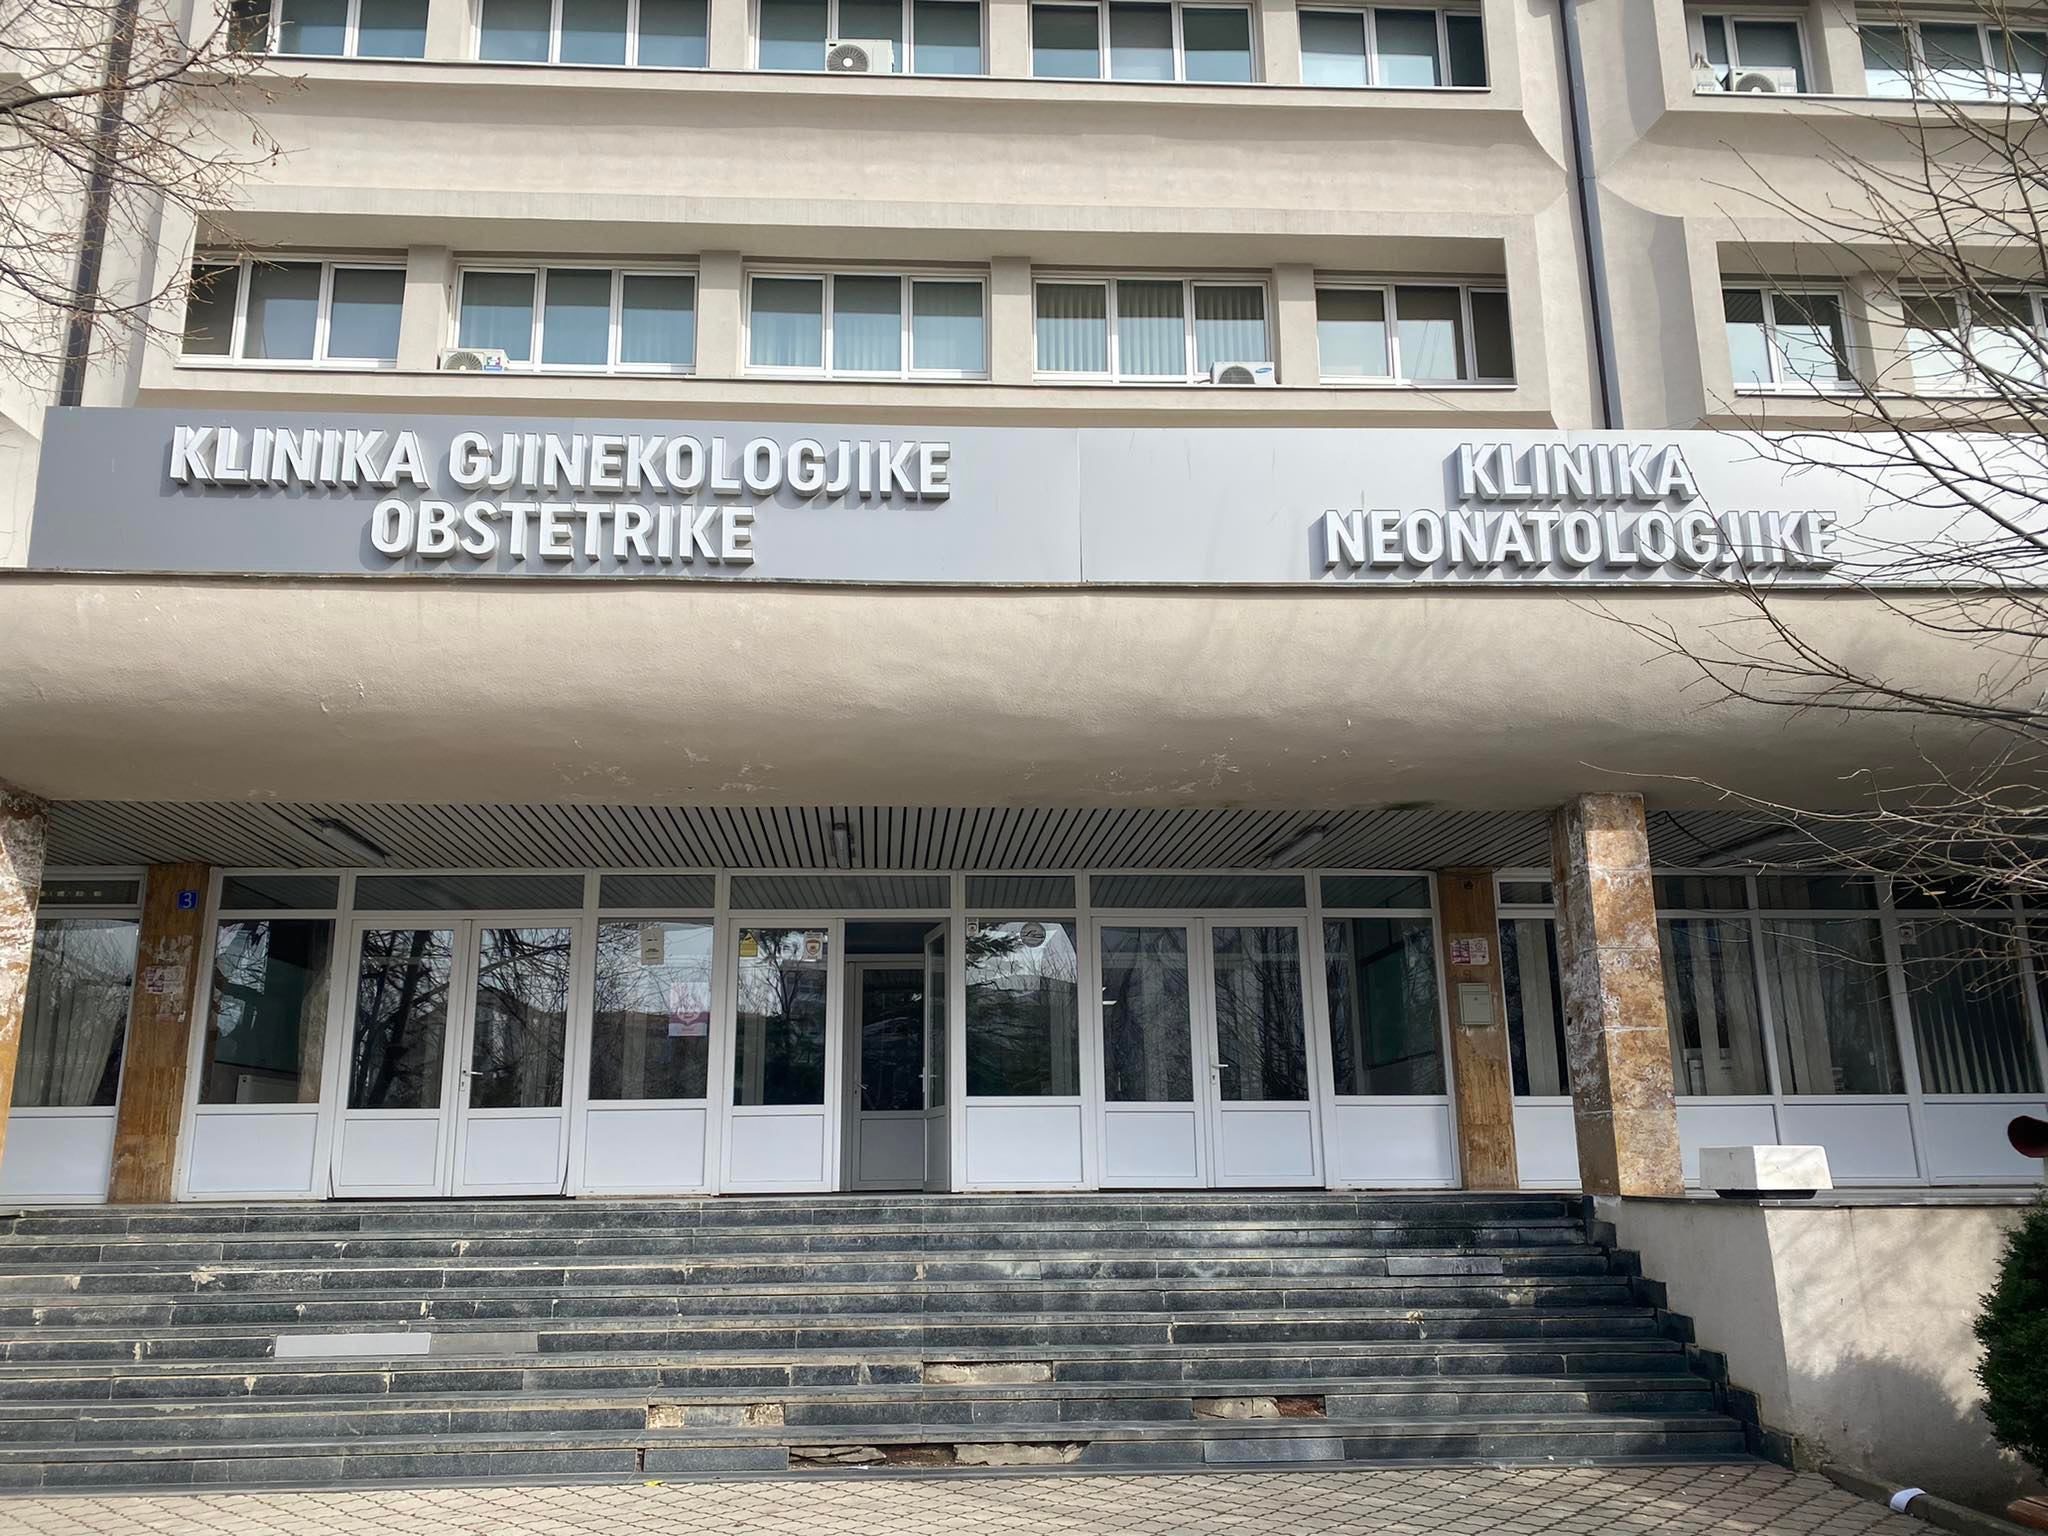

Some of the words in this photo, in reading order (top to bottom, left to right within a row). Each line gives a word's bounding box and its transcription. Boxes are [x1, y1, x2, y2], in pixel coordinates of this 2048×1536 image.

[170, 424, 430, 488] KLINIKA
[449, 431, 951, 500] GJINEKOLOGJIKE
[1459, 443, 1698, 500] KLINIKA
[371, 499, 755, 564] OBSTETRIKE
[1323, 510, 1842, 568] NEONATOLOGJIKE
[183, 892, 193, 909] 3
